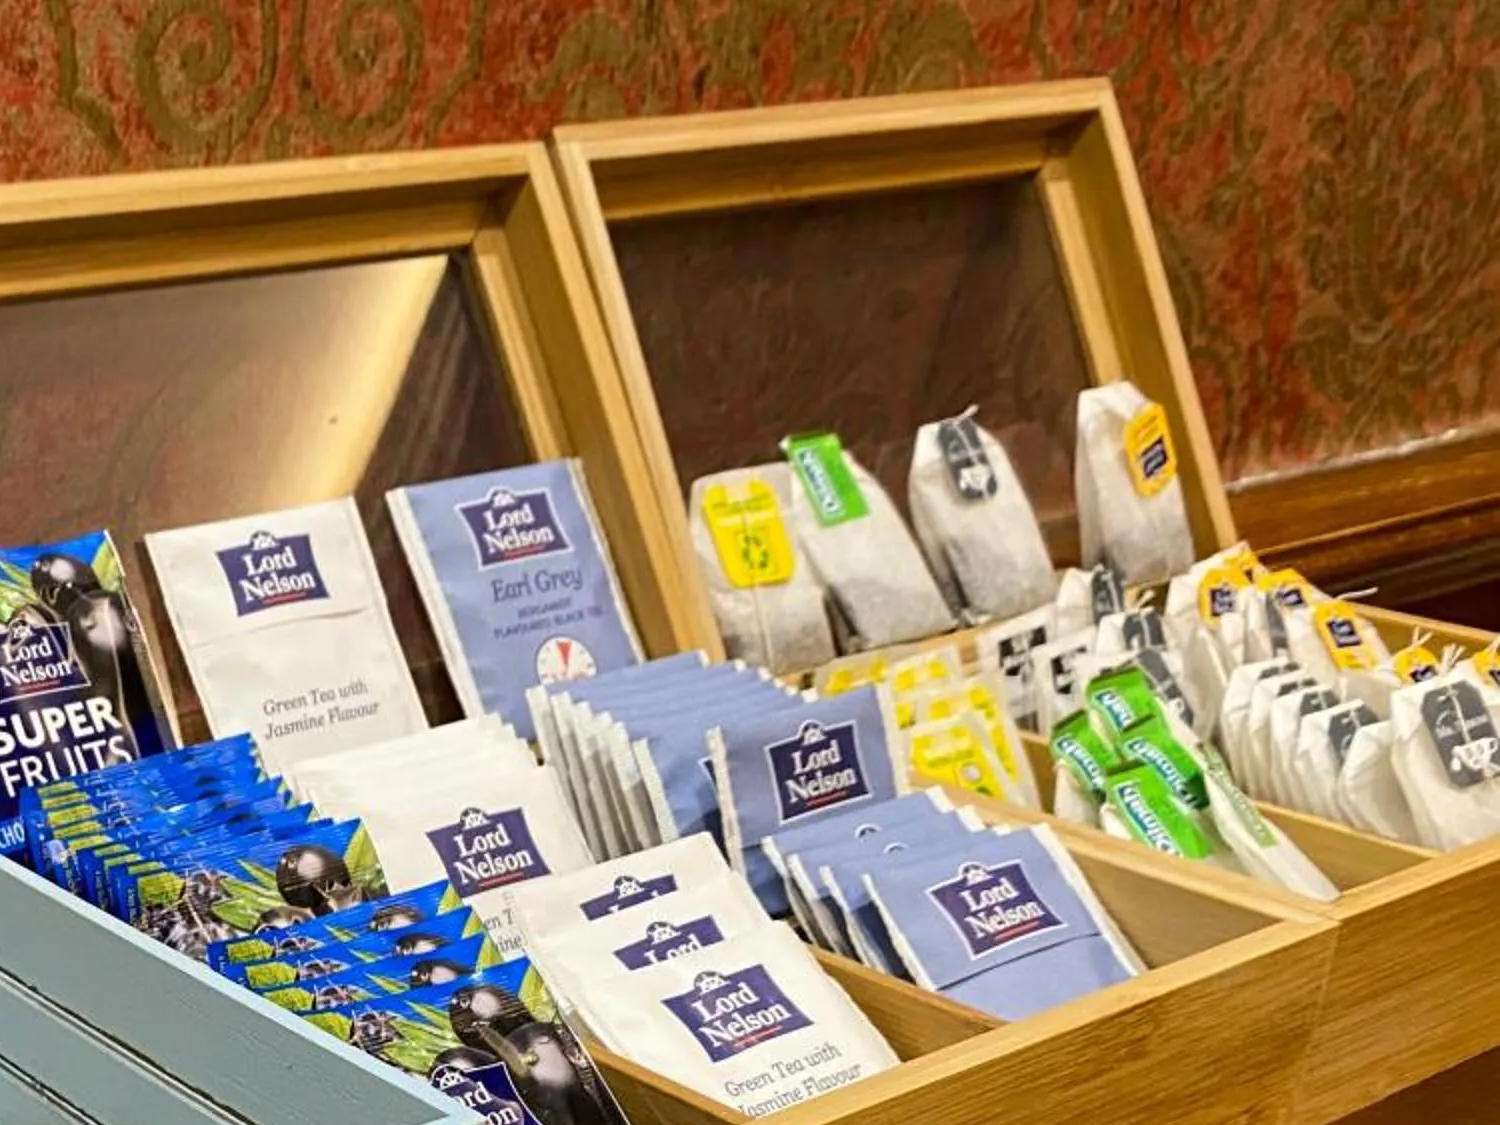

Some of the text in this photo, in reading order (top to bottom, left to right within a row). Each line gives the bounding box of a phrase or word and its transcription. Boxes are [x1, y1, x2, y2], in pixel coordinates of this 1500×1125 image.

[484, 502, 535, 534] Lord
[481, 522, 554, 555] Nelson
[243, 546, 297, 576] Lord
[239, 570, 316, 602] Nelson
[491, 568, 584, 603] Earl Grey
[3, 636, 53, 662] Lord
[0, 659, 73, 687] Nelson
[263, 678, 368, 717] Green Tea with
[264, 702, 380, 741] Jasmine Flavour
[0, 735, 134, 798] FRUITS
[791, 738, 842, 776] Lord
[785, 765, 859, 804] Nelson
[453, 822, 511, 858] Lord
[453, 848, 535, 885] Nelson
[959, 872, 1020, 911] Lord
[963, 899, 1046, 940] Nelson
[691, 981, 760, 1025] Lord
[699, 999, 793, 1049] Nelson
[724, 1041, 843, 1097] Green Tea with
[801, 1064, 862, 1097] Flavour
